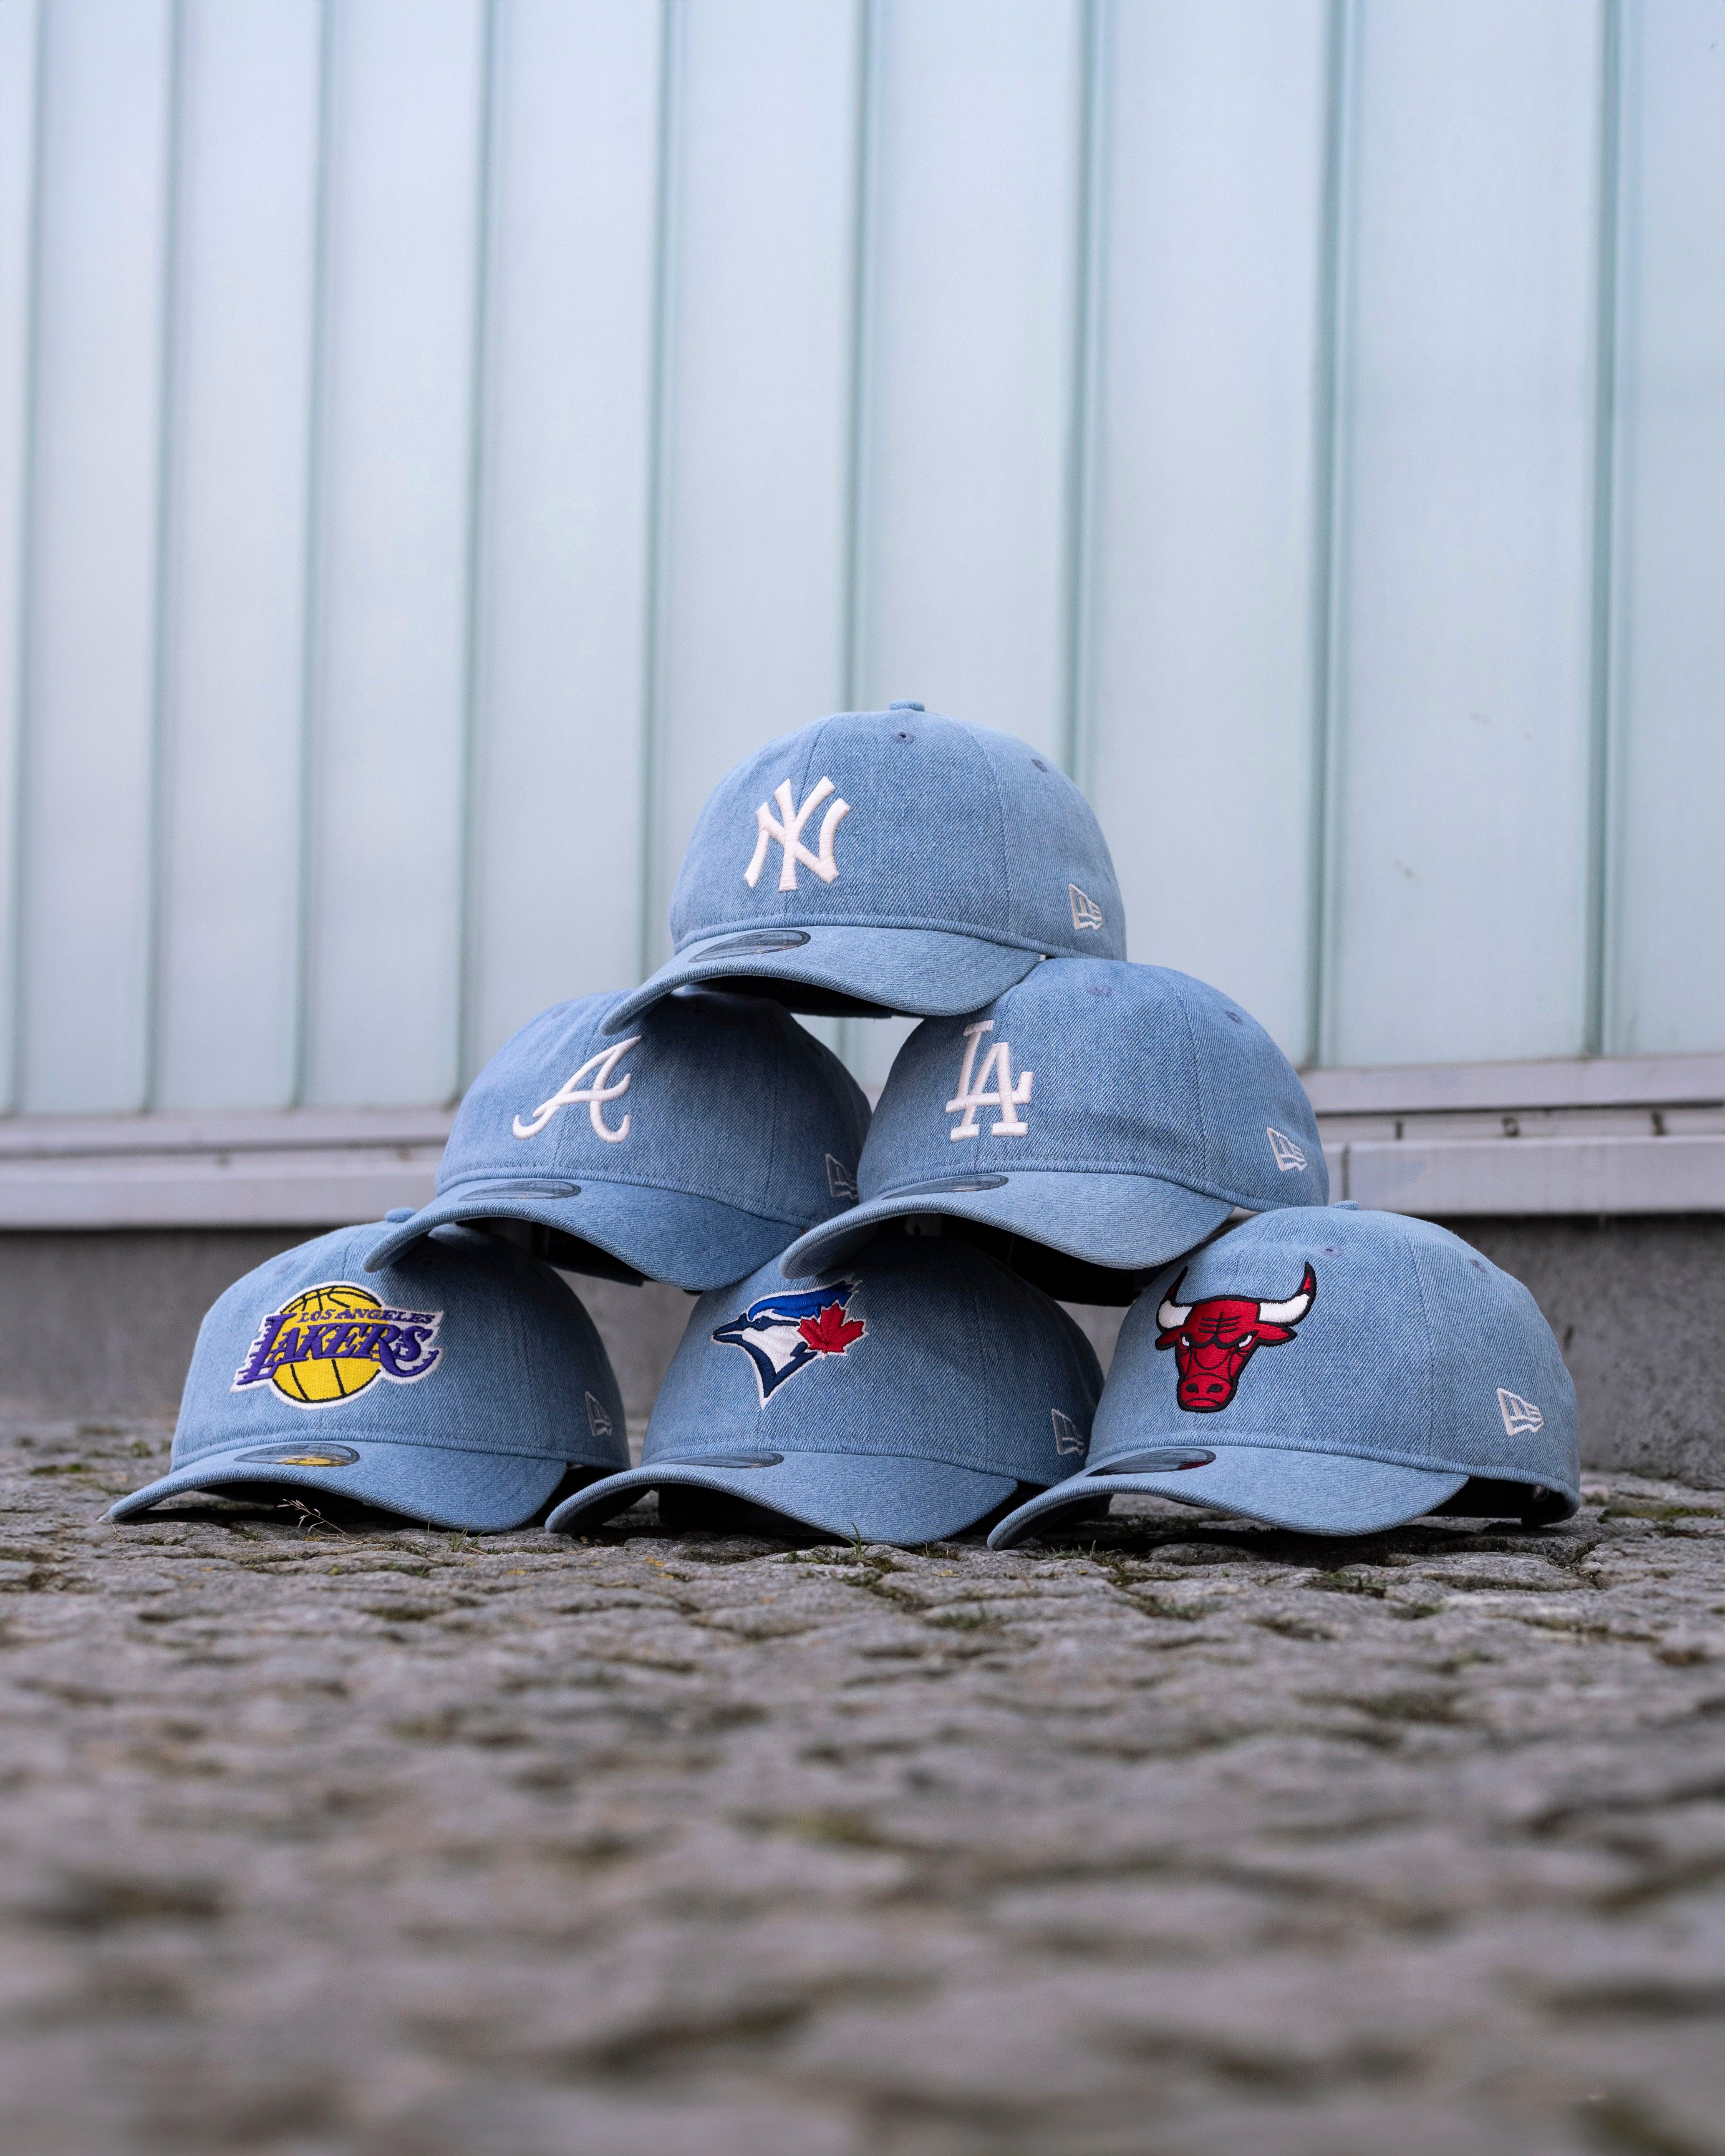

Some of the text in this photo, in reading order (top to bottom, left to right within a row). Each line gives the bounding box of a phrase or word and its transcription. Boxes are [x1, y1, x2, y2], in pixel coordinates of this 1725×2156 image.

[744, 776, 851, 893] NY
[512, 1035, 642, 1144] A
[946, 1020, 1034, 1142] LA
[236, 1312, 439, 1385] LAKERS
[297, 1308, 435, 1323] LOS ANGELES
